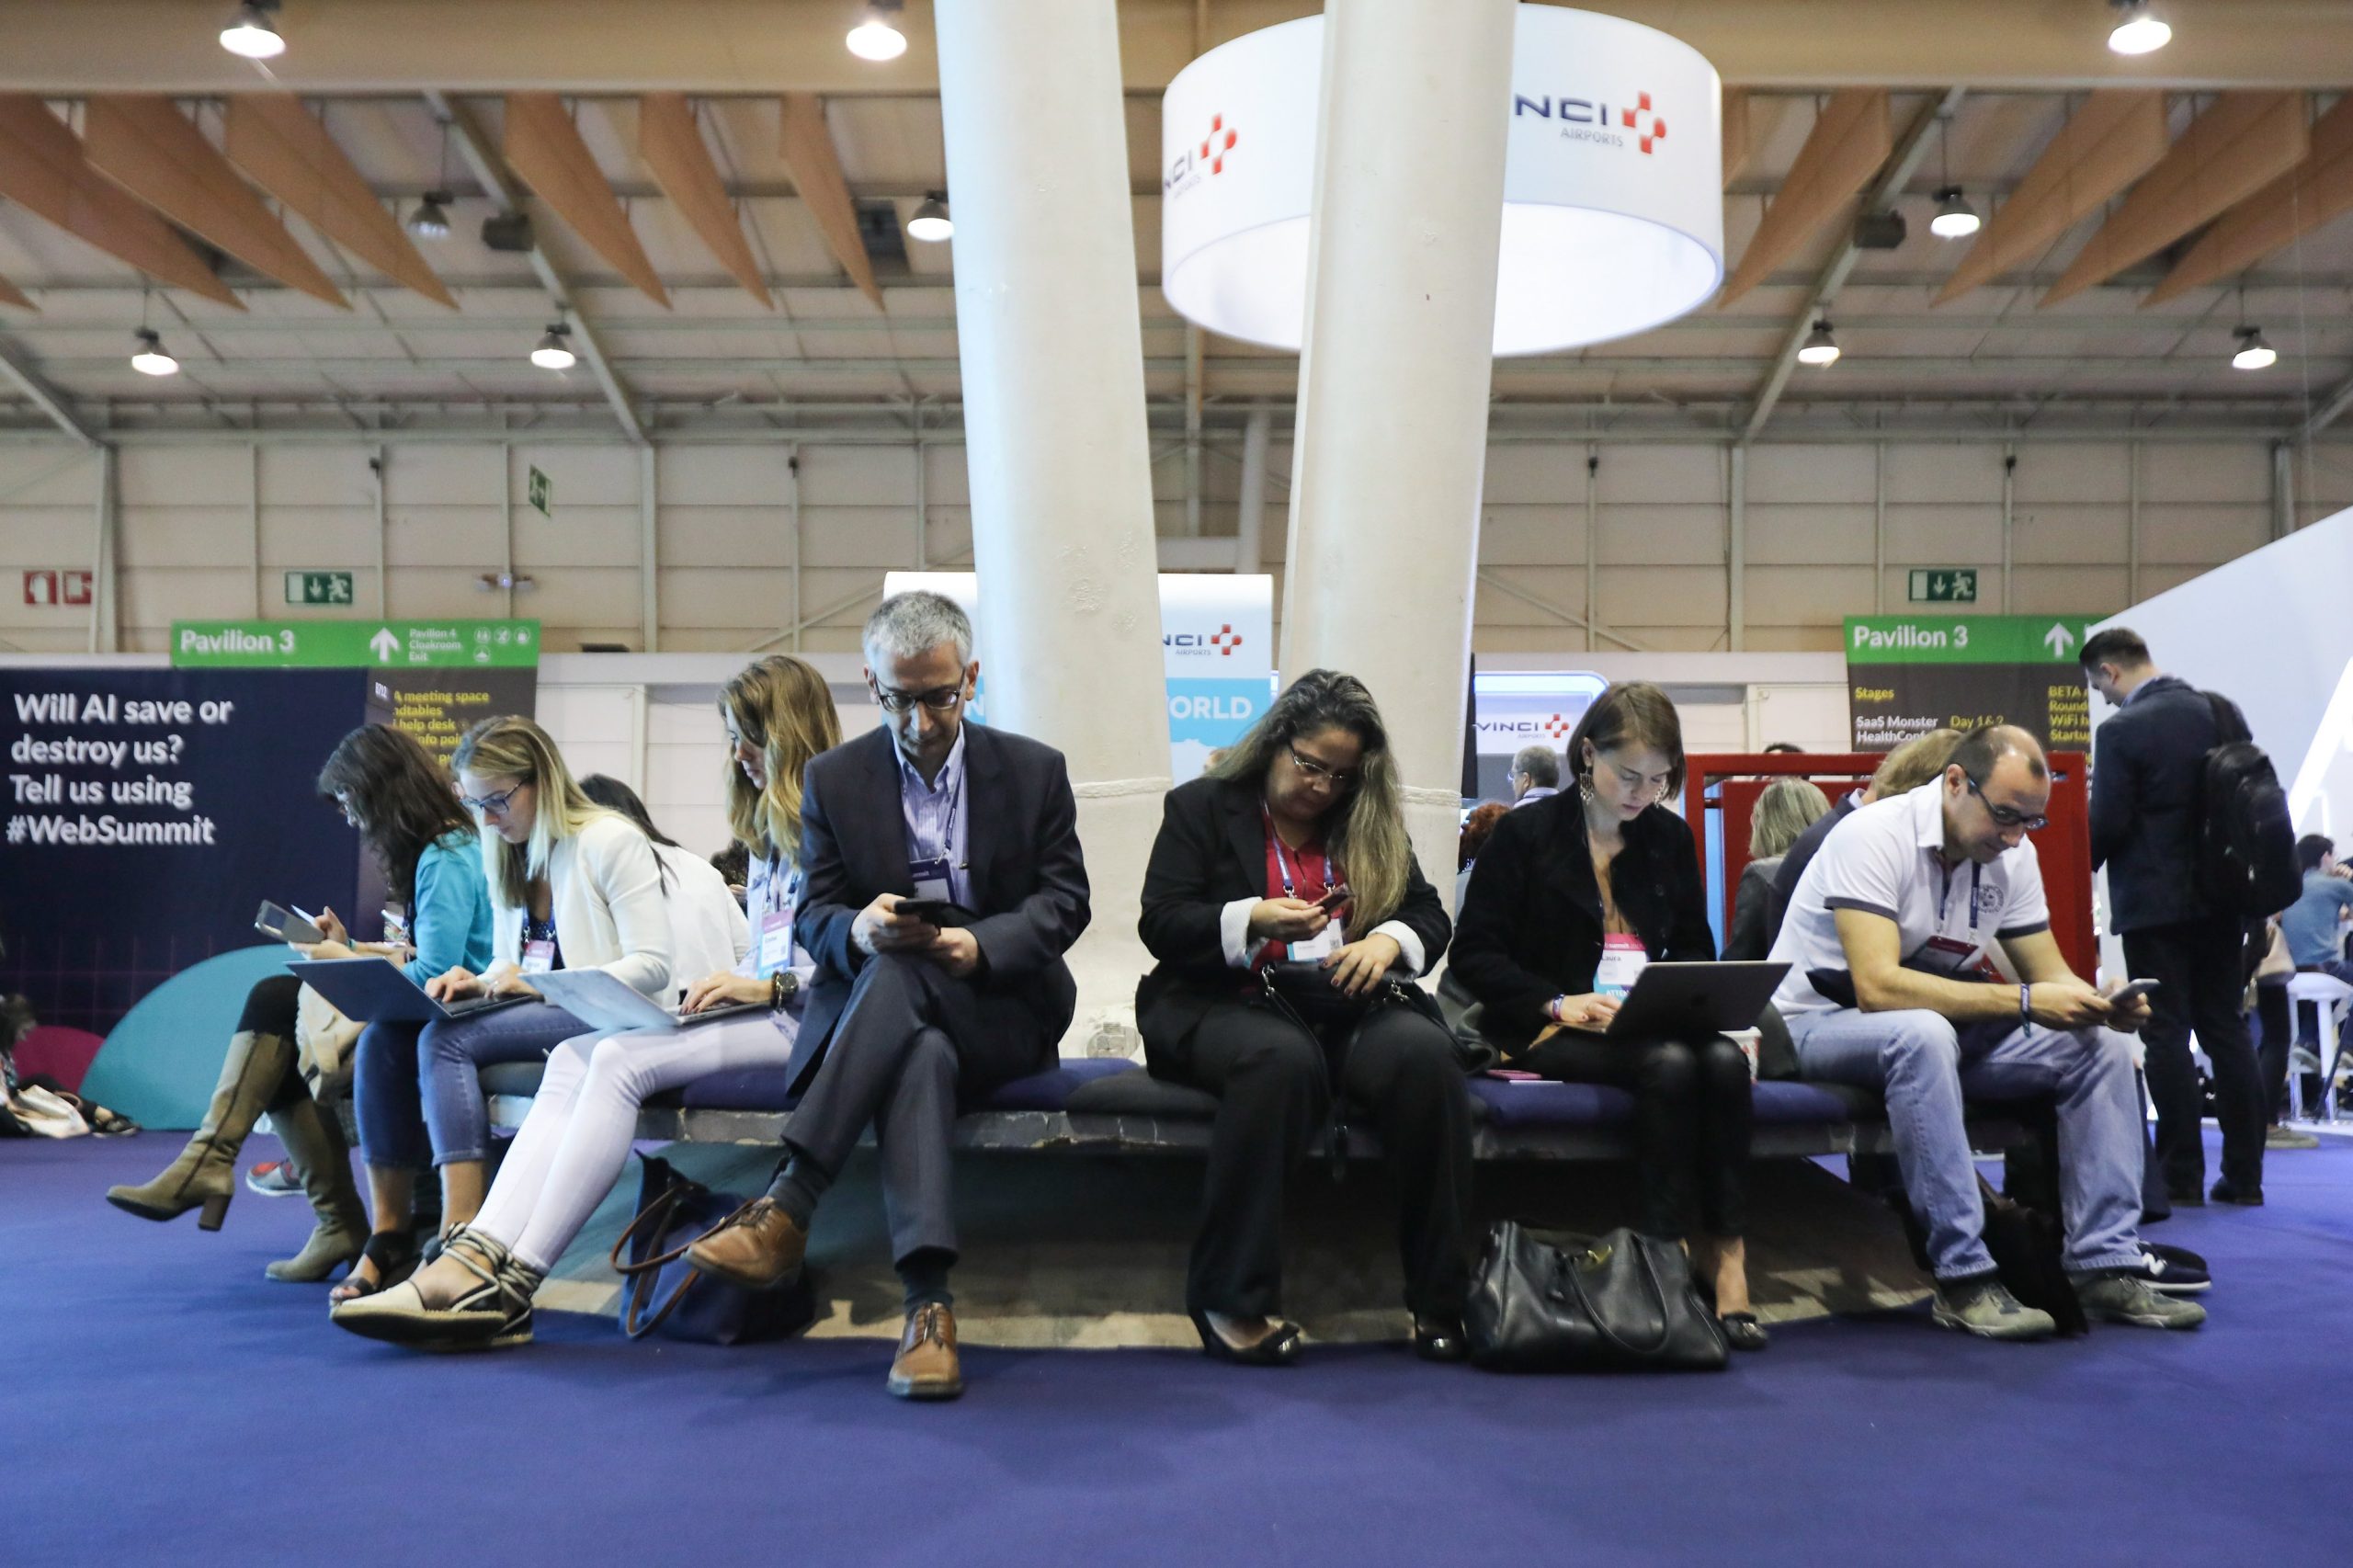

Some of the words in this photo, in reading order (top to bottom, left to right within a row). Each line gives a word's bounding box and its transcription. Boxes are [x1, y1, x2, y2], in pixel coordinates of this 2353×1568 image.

[1515, 93, 1607, 126] NCI
[1561, 127, 1624, 147] AIRPORTS
[180, 629, 275, 654] Pavilion
[278, 629, 295, 654] 3
[1853, 624, 1947, 649] Pavilion
[1953, 625, 1969, 648] 3
[404, 690, 453, 705] meeting
[455, 692, 489, 705] space
[1855, 687, 1894, 702] Stages
[2049, 686, 2082, 698] BETA
[14, 693, 76, 723] Will
[81, 694, 117, 722] AI
[123, 700, 193, 724] save
[199, 700, 233, 724] or
[1168, 695, 1253, 720] ORLD
[2049, 700, 2088, 713] Round
[399, 719, 425, 732] help
[427, 718, 457, 731] desk
[1471, 722, 1539, 732] VINCI
[1856, 715, 1885, 729] SaaS
[1887, 714, 1938, 729] Monster
[1949, 715, 1974, 729] Day
[11, 733, 128, 768] destroy
[133, 733, 184, 764] us?
[9, 774, 62, 804] Tell
[69, 781, 104, 804] us
[111, 774, 193, 809] using
[6, 814, 215, 845] #WebSummit
